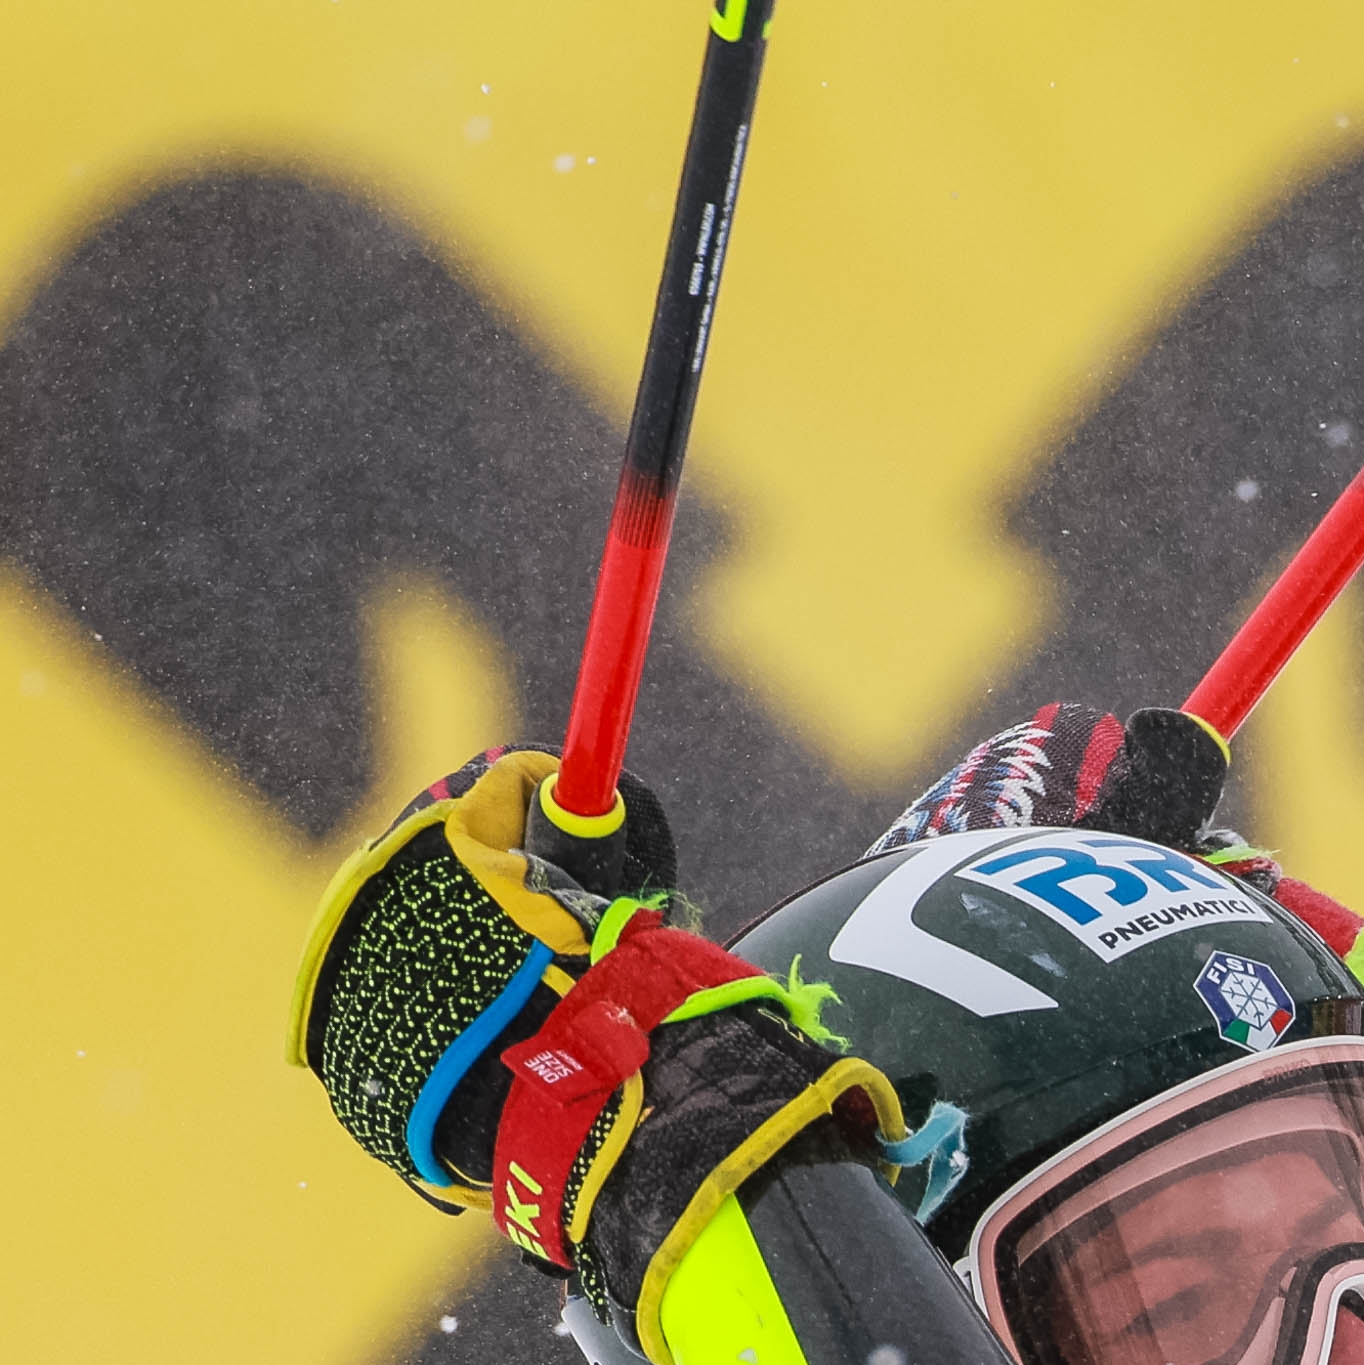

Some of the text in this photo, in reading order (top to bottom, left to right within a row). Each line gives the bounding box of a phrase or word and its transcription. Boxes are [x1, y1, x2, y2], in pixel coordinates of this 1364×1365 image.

[1098, 899, 1254, 950] PNEUMATICI
[1206, 957, 1256, 985] FISI
[523, 1058, 560, 1084] ONE
[536, 1050, 575, 1078] SIZE
